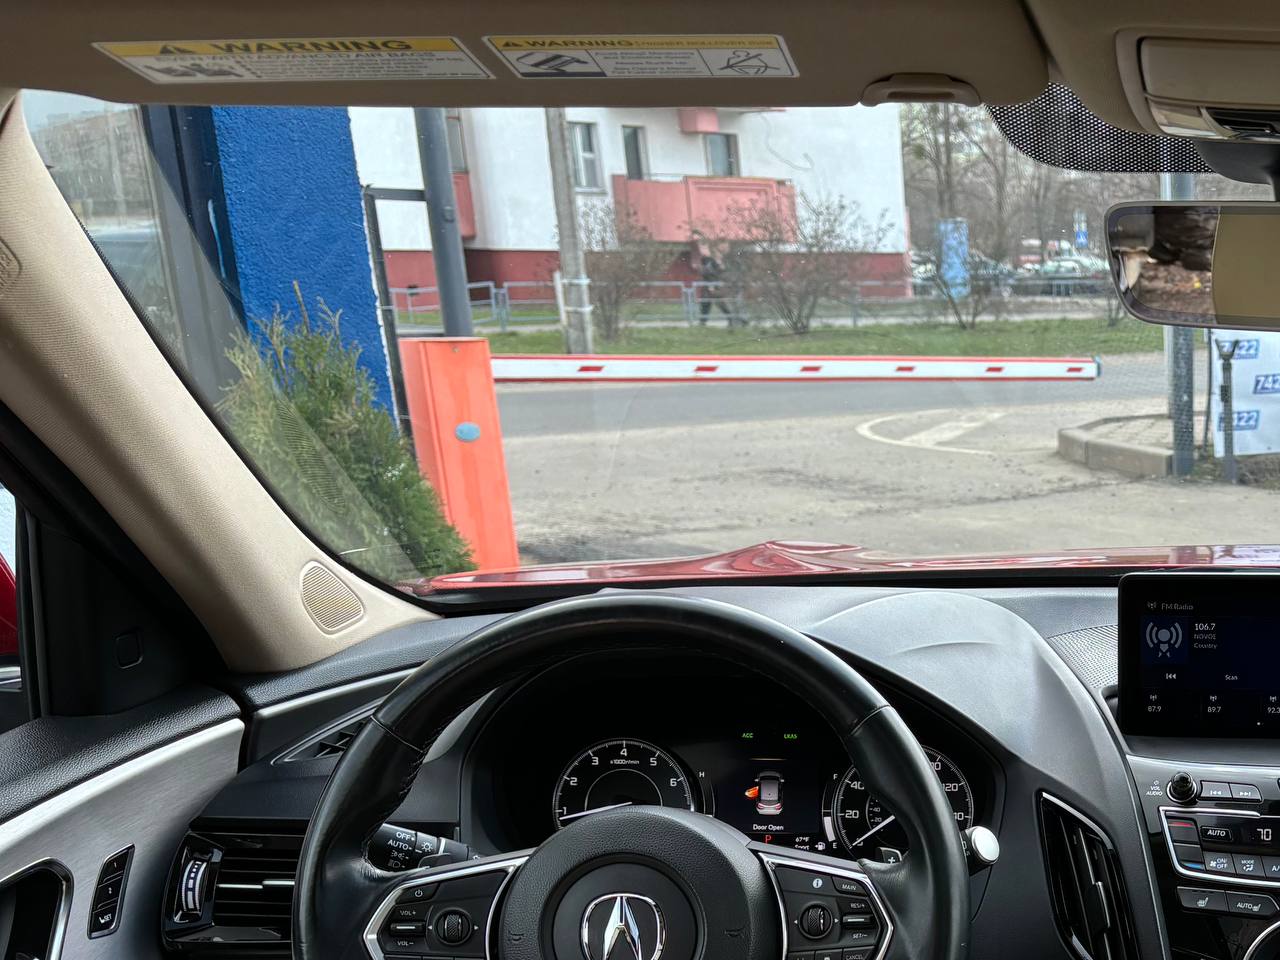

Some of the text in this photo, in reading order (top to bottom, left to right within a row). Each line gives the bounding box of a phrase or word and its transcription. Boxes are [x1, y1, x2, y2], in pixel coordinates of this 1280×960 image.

[209, 40, 413, 54] WARNING
[1220, 340, 1259, 354] 722
[1194, 622, 1216, 632] 106.7
[1147, 705, 1162, 713] 87.9
[1207, 705, 1221, 713] 89.7
[1266, 706, 1280, 714] 92.3
[619, 748, 628, 757] 4
[591, 756, 600, 766] 3
[649, 757, 658, 767] 5
[569, 777, 578, 786] 2
[669, 778, 678, 787] 6
[850, 781, 865, 790] 40
[845, 810, 860, 819] 20
[768, 824, 785, 832] Open
[396, 831, 412, 841] OFF
[1206, 829, 1226, 837] AUTO
[1256, 828, 1272, 842] 70
[387, 839, 410, 851] AUTO
[1236, 901, 1252, 909] AUTO
